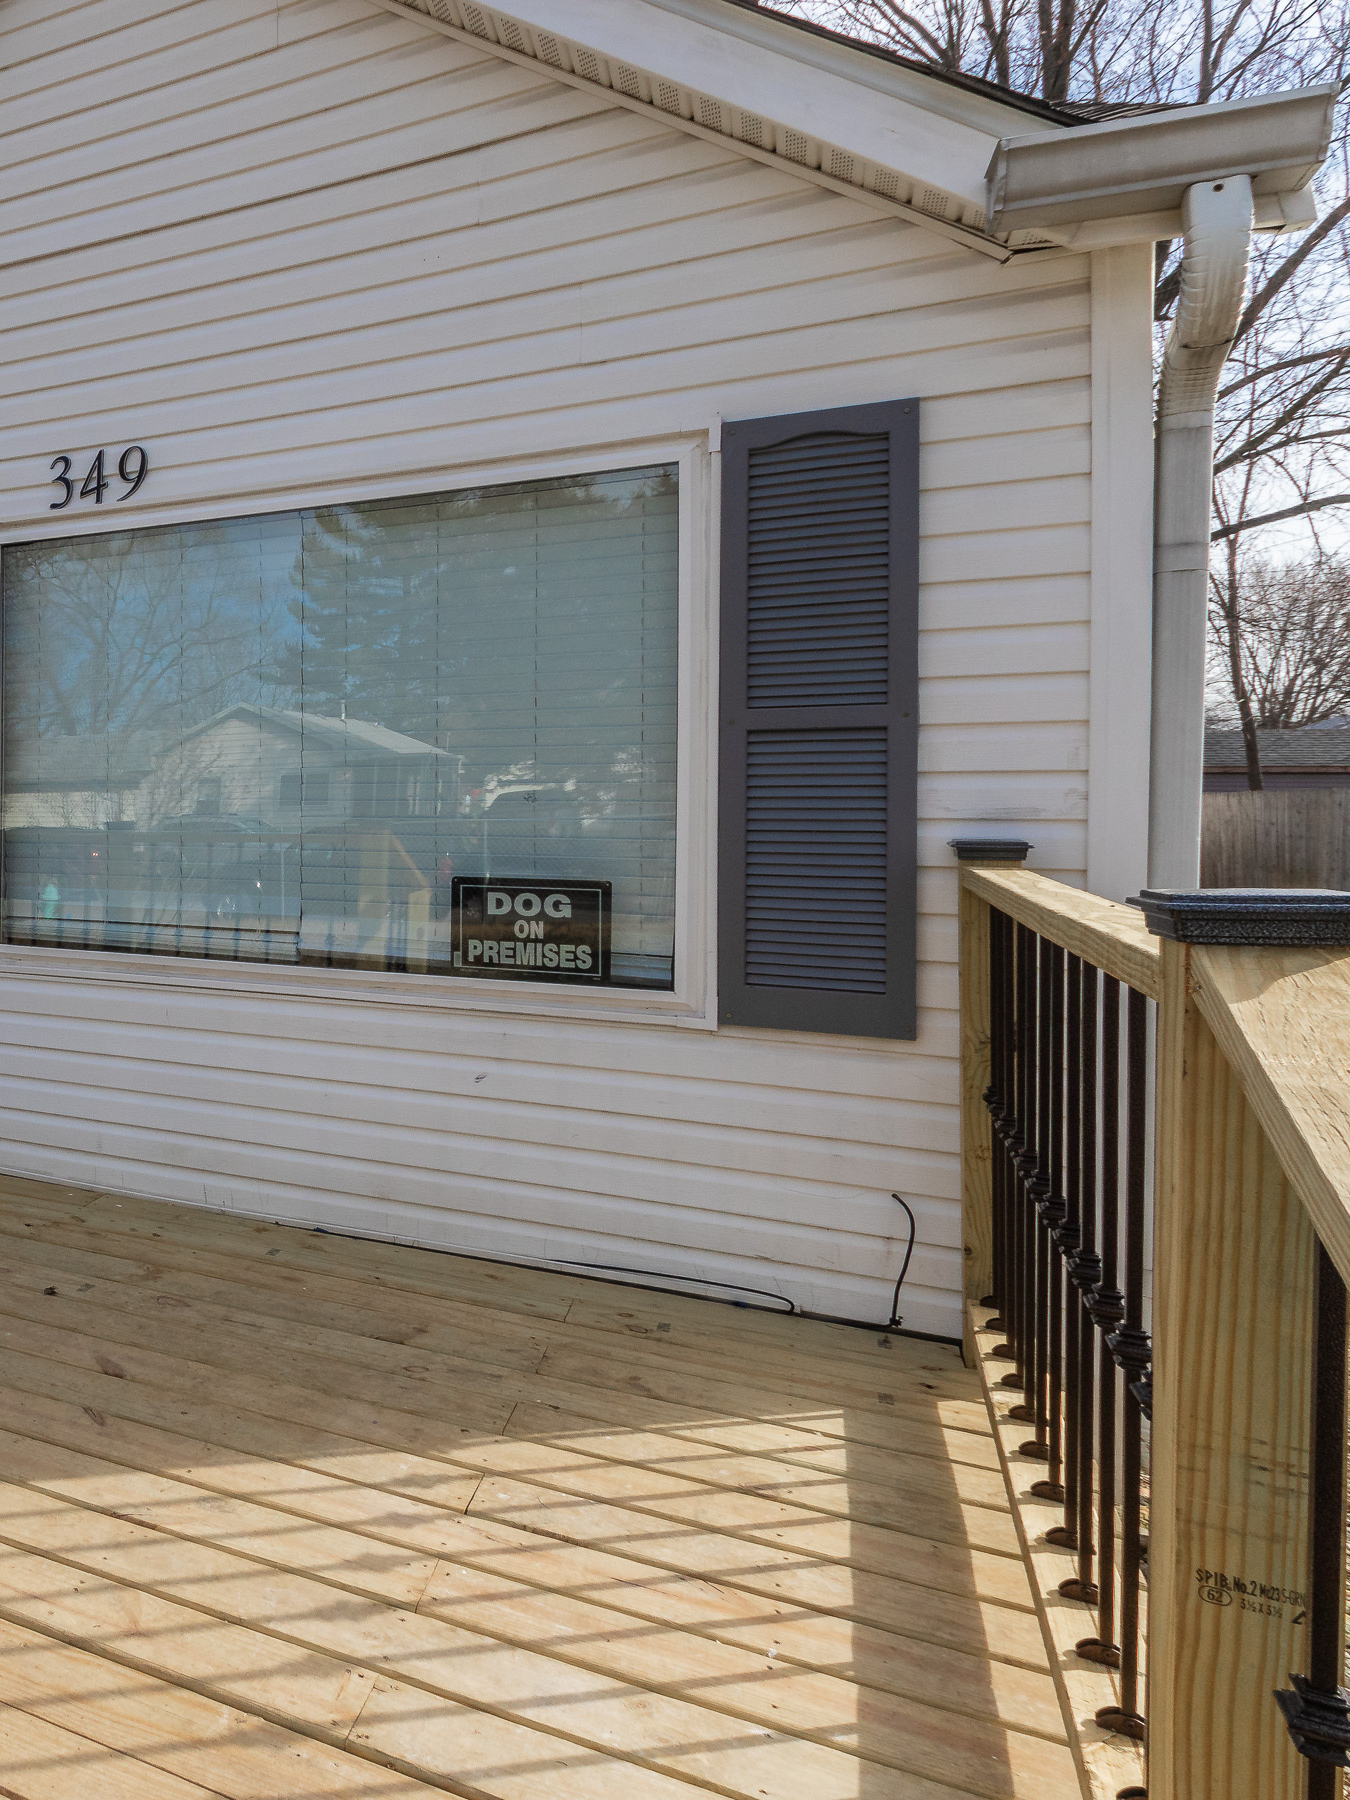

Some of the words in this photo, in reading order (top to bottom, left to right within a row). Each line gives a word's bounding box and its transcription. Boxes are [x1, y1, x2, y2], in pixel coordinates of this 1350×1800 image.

[49, 446, 148, 510] 349
[487, 891, 572, 918] DOG
[513, 919, 544, 940] ON
[467, 939, 593, 970] PREMISES
[1207, 1588, 1223, 1603] 62
